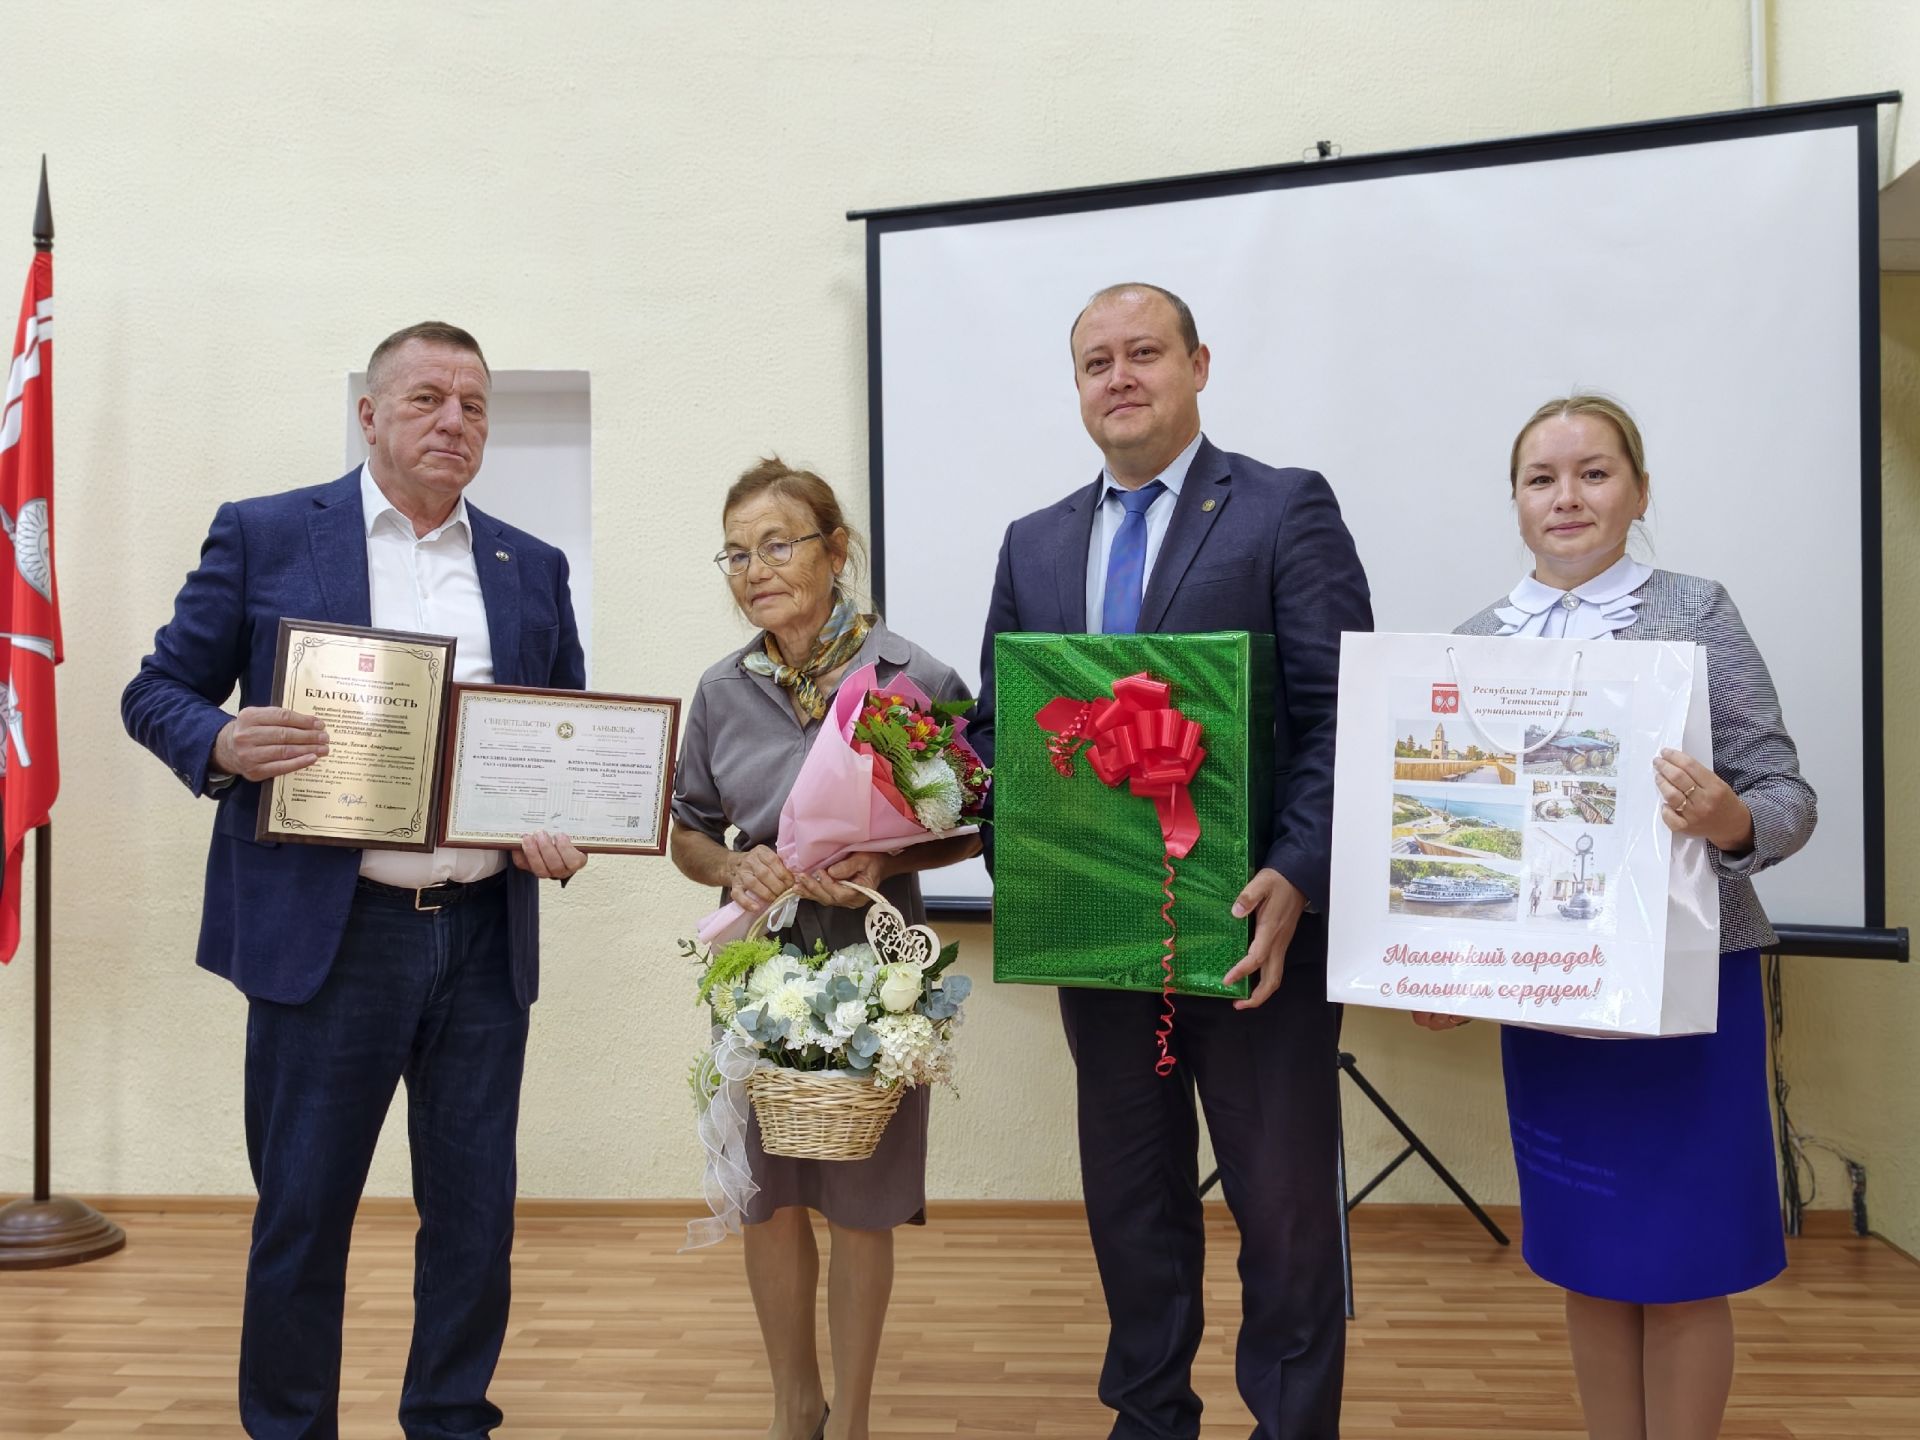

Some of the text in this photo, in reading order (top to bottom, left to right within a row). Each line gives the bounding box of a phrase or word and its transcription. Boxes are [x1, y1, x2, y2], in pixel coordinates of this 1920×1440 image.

[305, 687, 418, 708] БЛАГОДАРНОСТЬ
[1472, 686, 1528, 697] Республика
[1500, 696, 1560, 706] Тетюшский
[1474, 708, 1552, 717] муниципальный
[1382, 943, 1605, 973] Маленький городок
[1380, 976, 1602, 1006] с большим сердцем!
